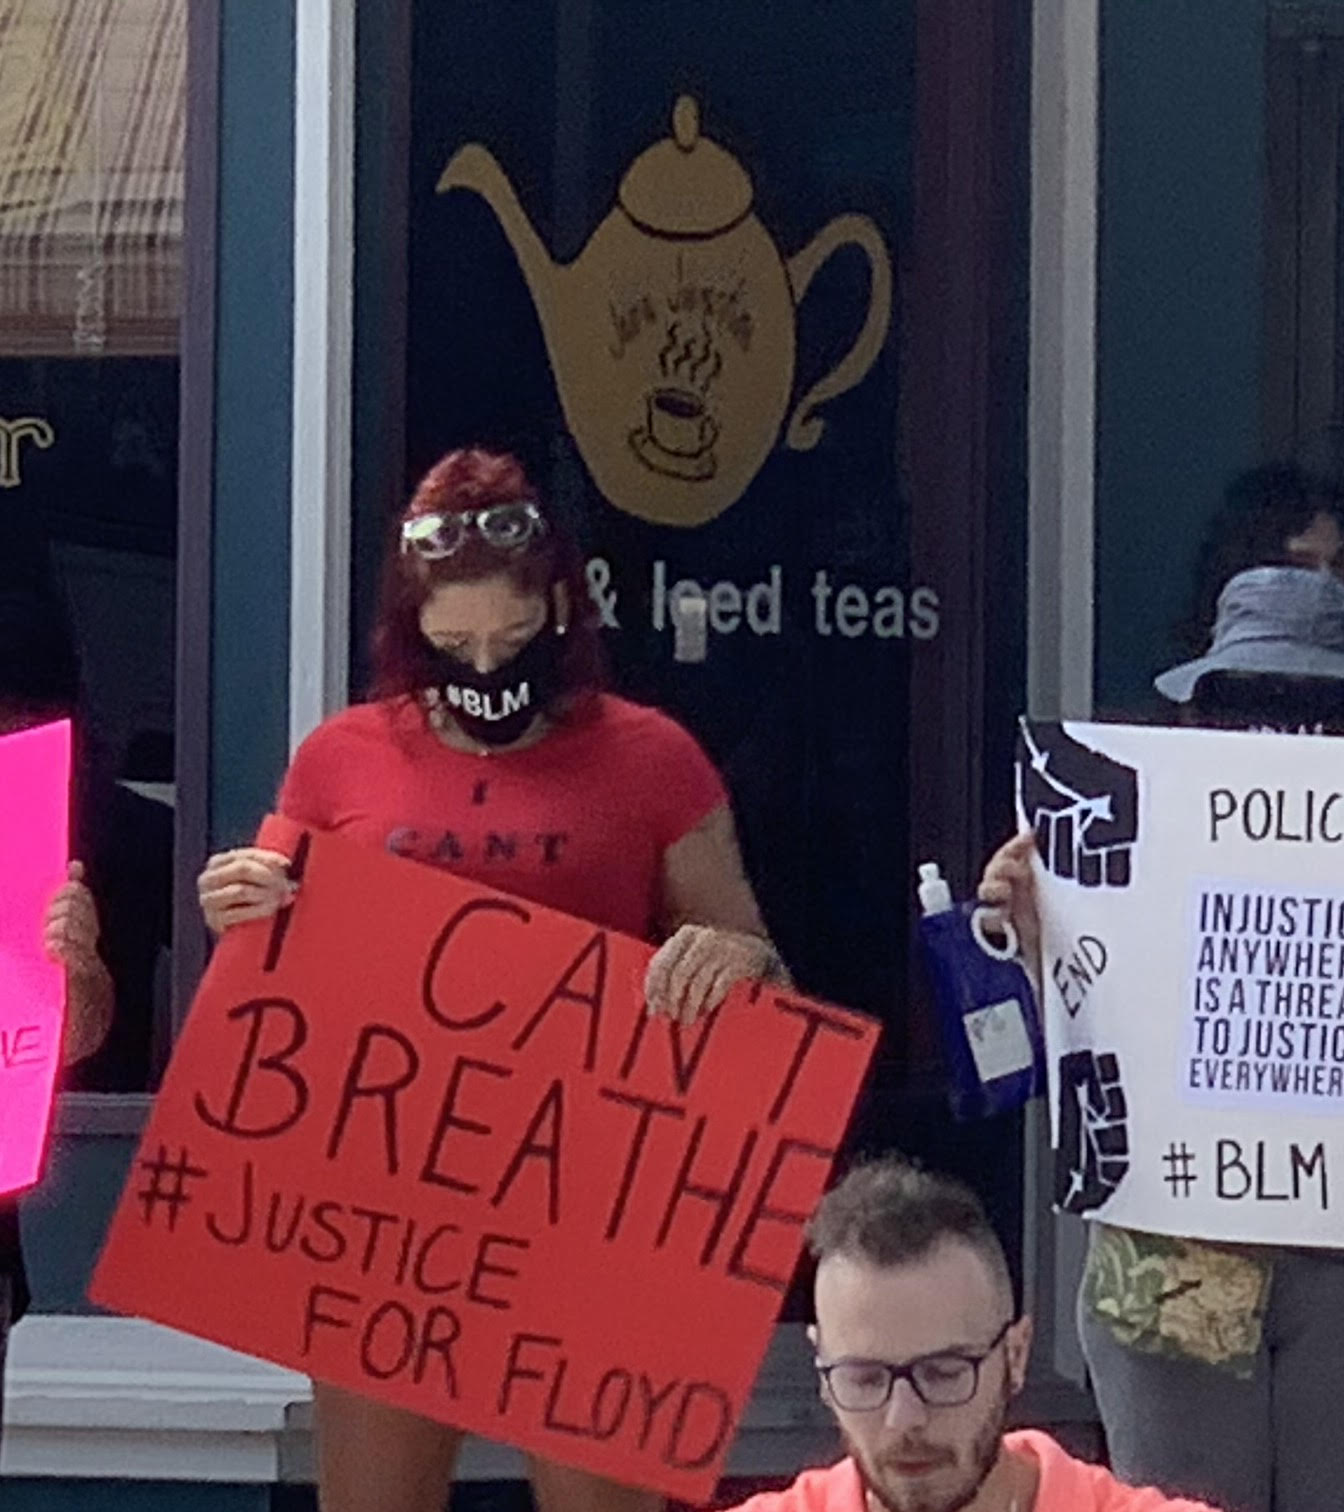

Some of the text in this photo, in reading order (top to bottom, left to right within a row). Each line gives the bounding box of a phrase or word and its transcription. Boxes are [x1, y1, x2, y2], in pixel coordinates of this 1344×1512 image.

[586, 557, 621, 630] &
[811, 570, 941, 640] teas
[446, 682, 530, 721] #BLM
[262, 829, 864, 1124] I CAN'T
[1052, 934, 1108, 1018] END
[1194, 976, 1222, 1013] IS
[1228, 977, 1246, 1016] A
[1193, 1016, 1231, 1056] TO
[194, 998, 833, 1293] BREATHE
[137, 1144, 530, 1311] #JUSTICE
[301, 1286, 733, 1471] FOR FLOYD
